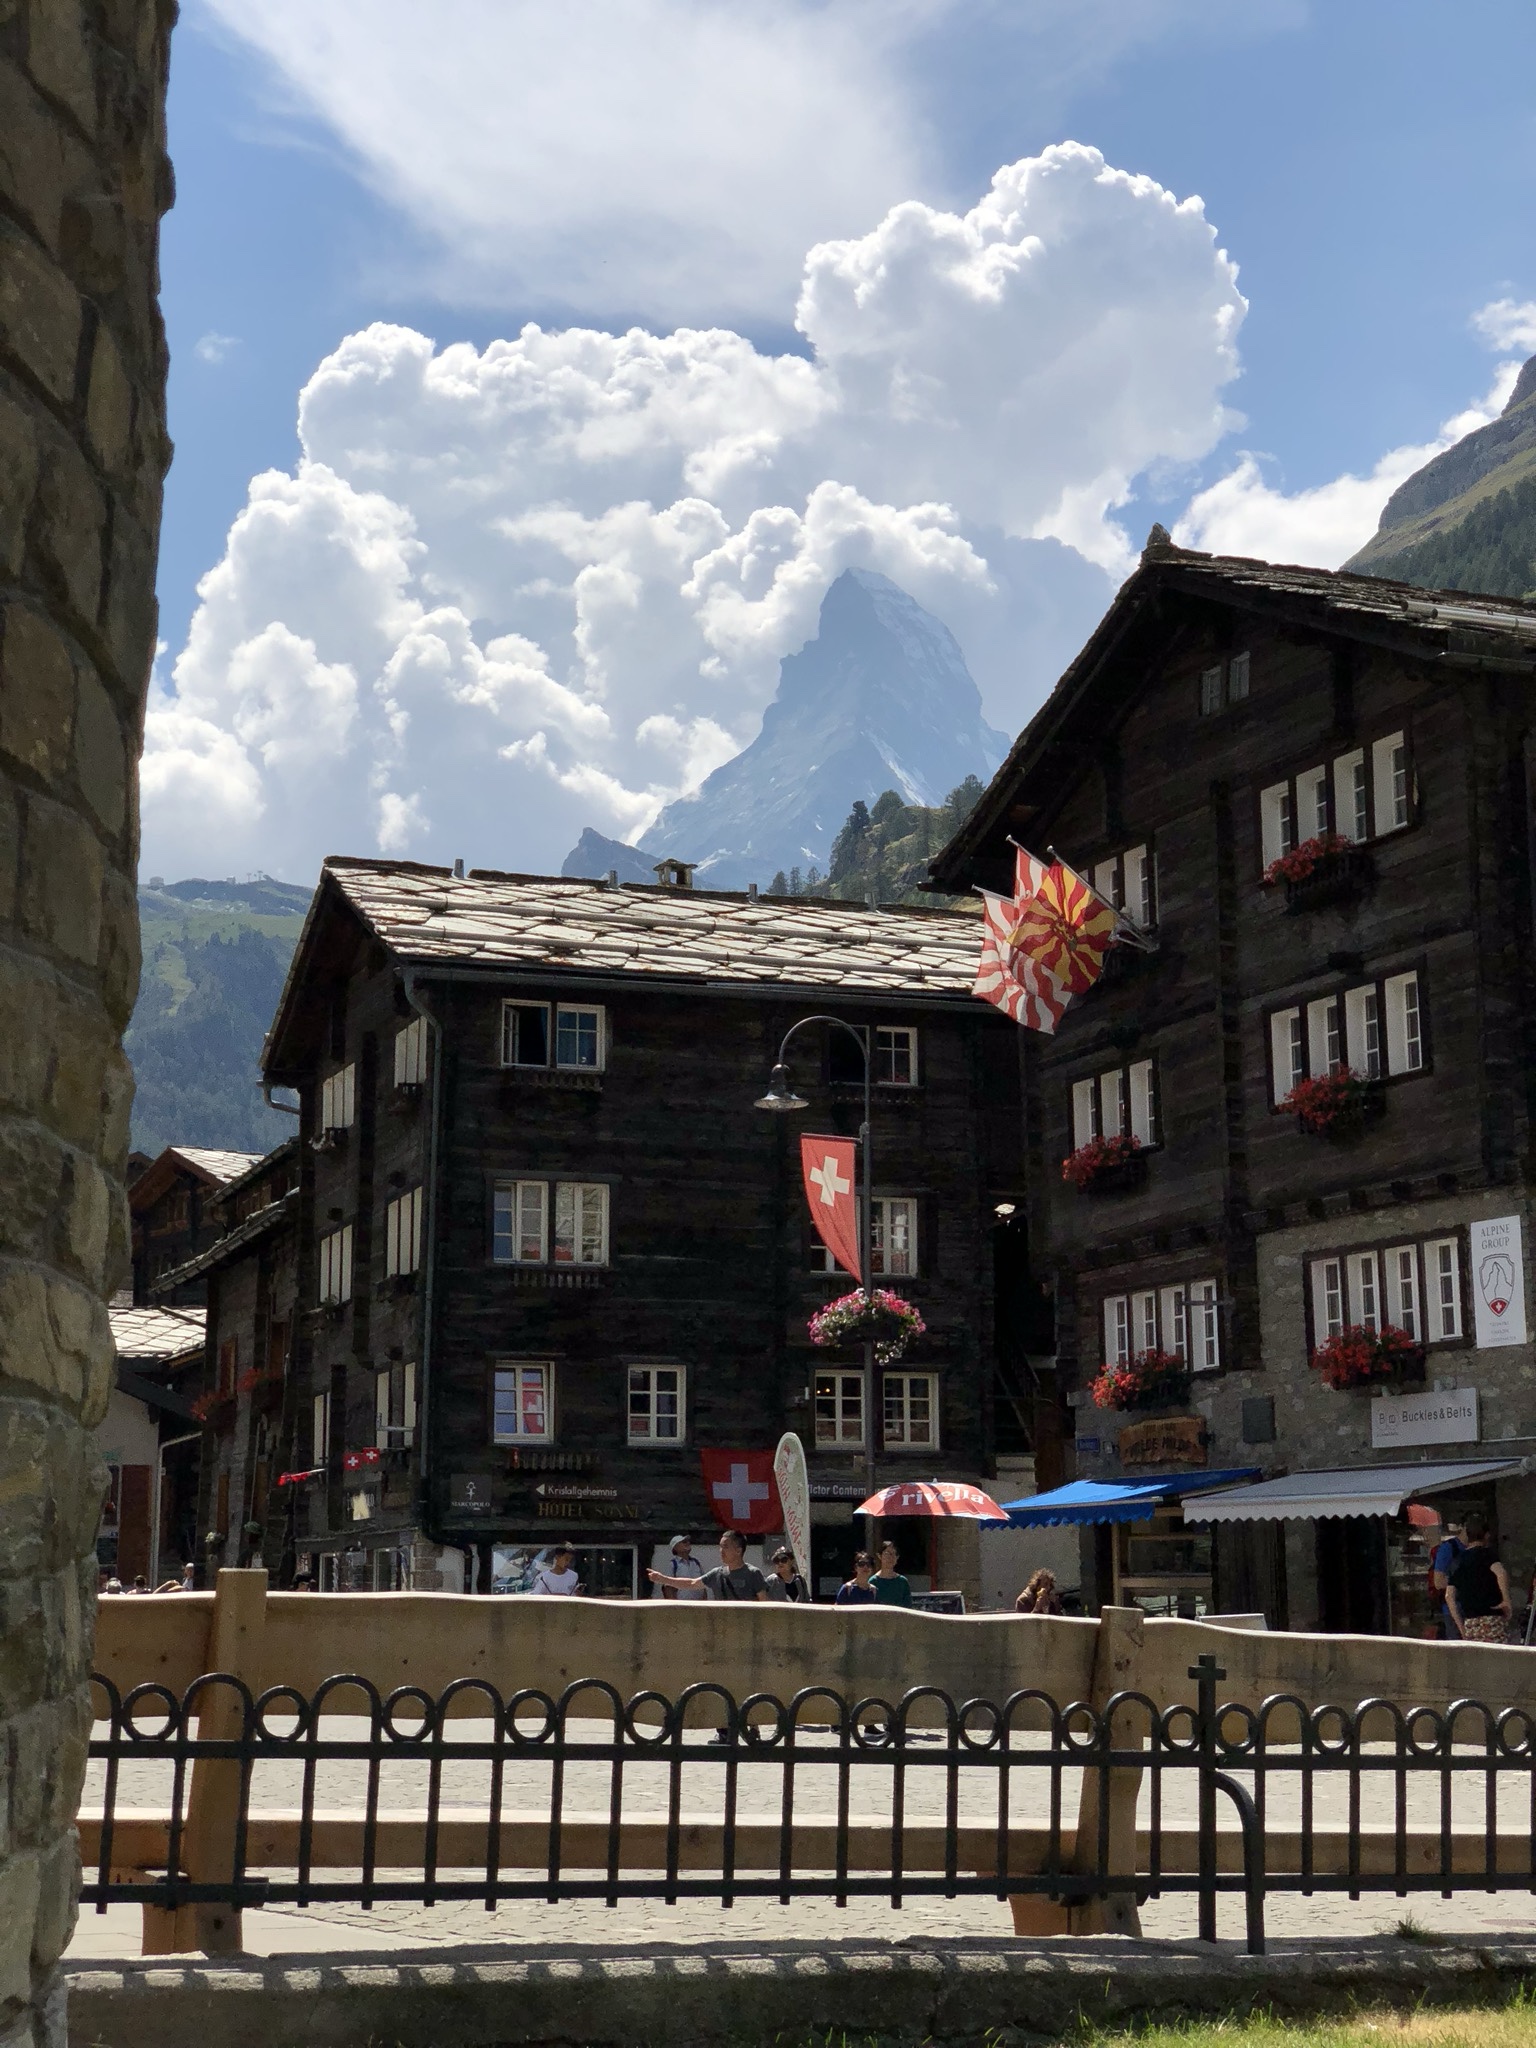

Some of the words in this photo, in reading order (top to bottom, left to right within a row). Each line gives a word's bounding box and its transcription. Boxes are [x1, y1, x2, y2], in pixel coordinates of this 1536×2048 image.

[1480, 1224, 1511, 1237] ALPINE
[1481, 1236, 1510, 1250] GROUP
[548, 1485, 618, 1499] Kristallgeheimnis
[902, 1487, 984, 1506] rivella
